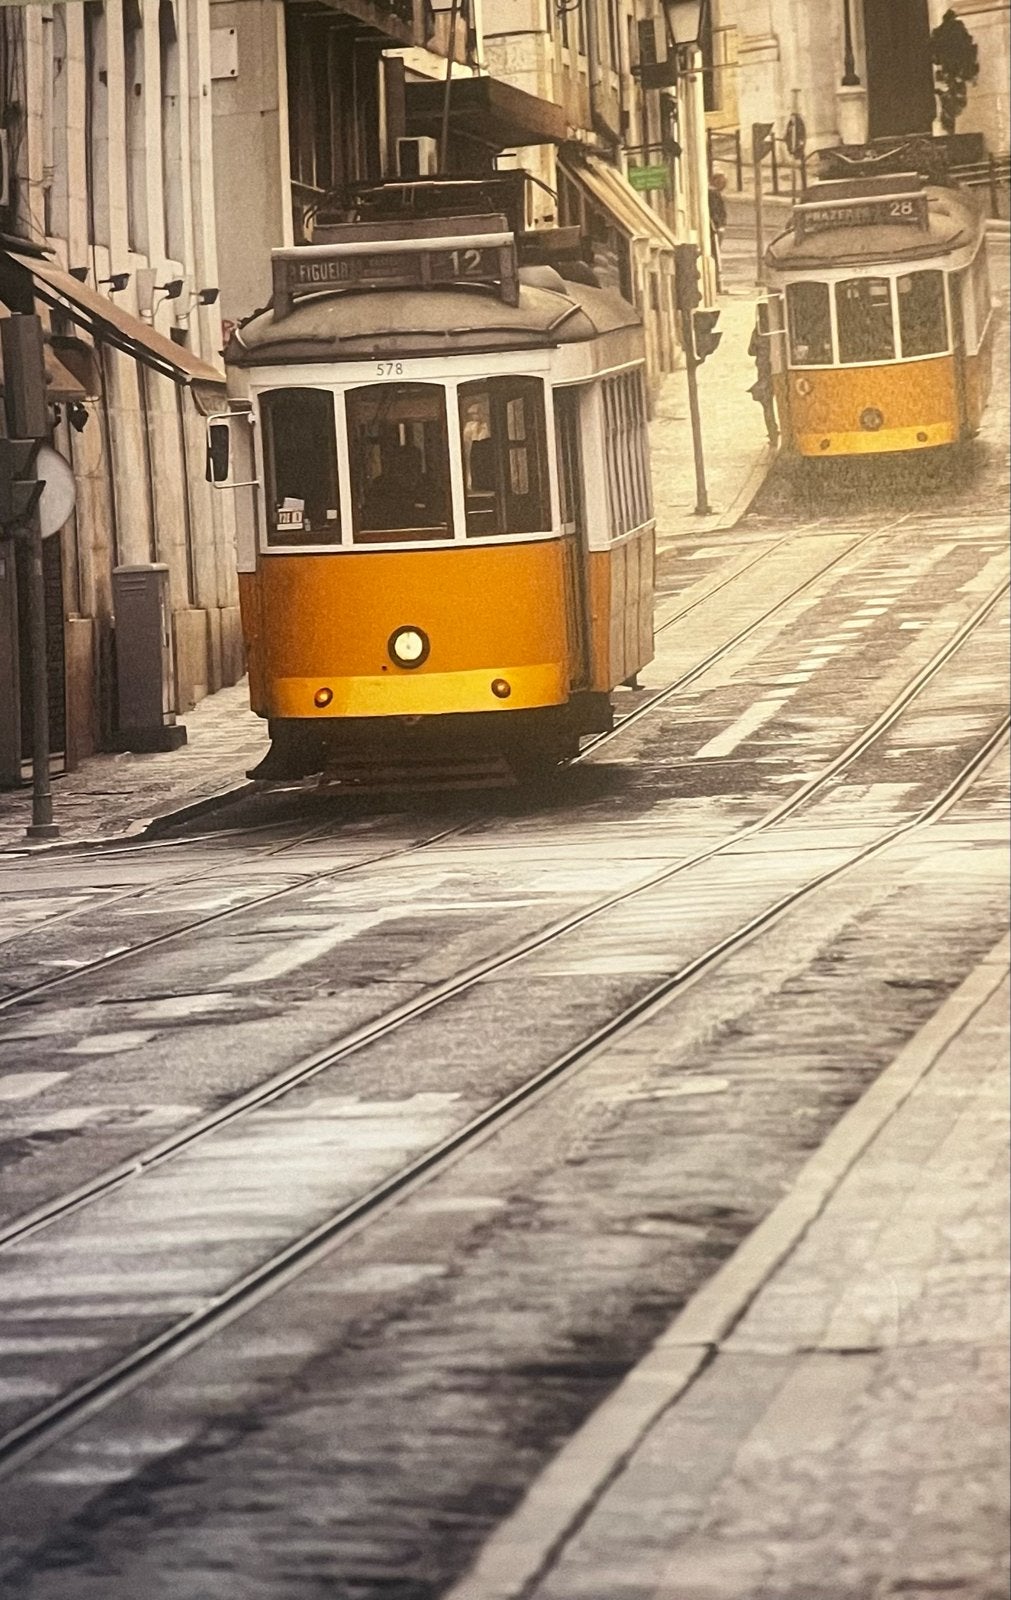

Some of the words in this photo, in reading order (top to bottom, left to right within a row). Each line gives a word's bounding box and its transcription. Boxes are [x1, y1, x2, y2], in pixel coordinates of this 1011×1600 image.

[890, 201, 913, 216] 28
[300, 260, 361, 282] FIGUEIR
[449, 249, 483, 276] 12
[376, 362, 403, 376] 578
